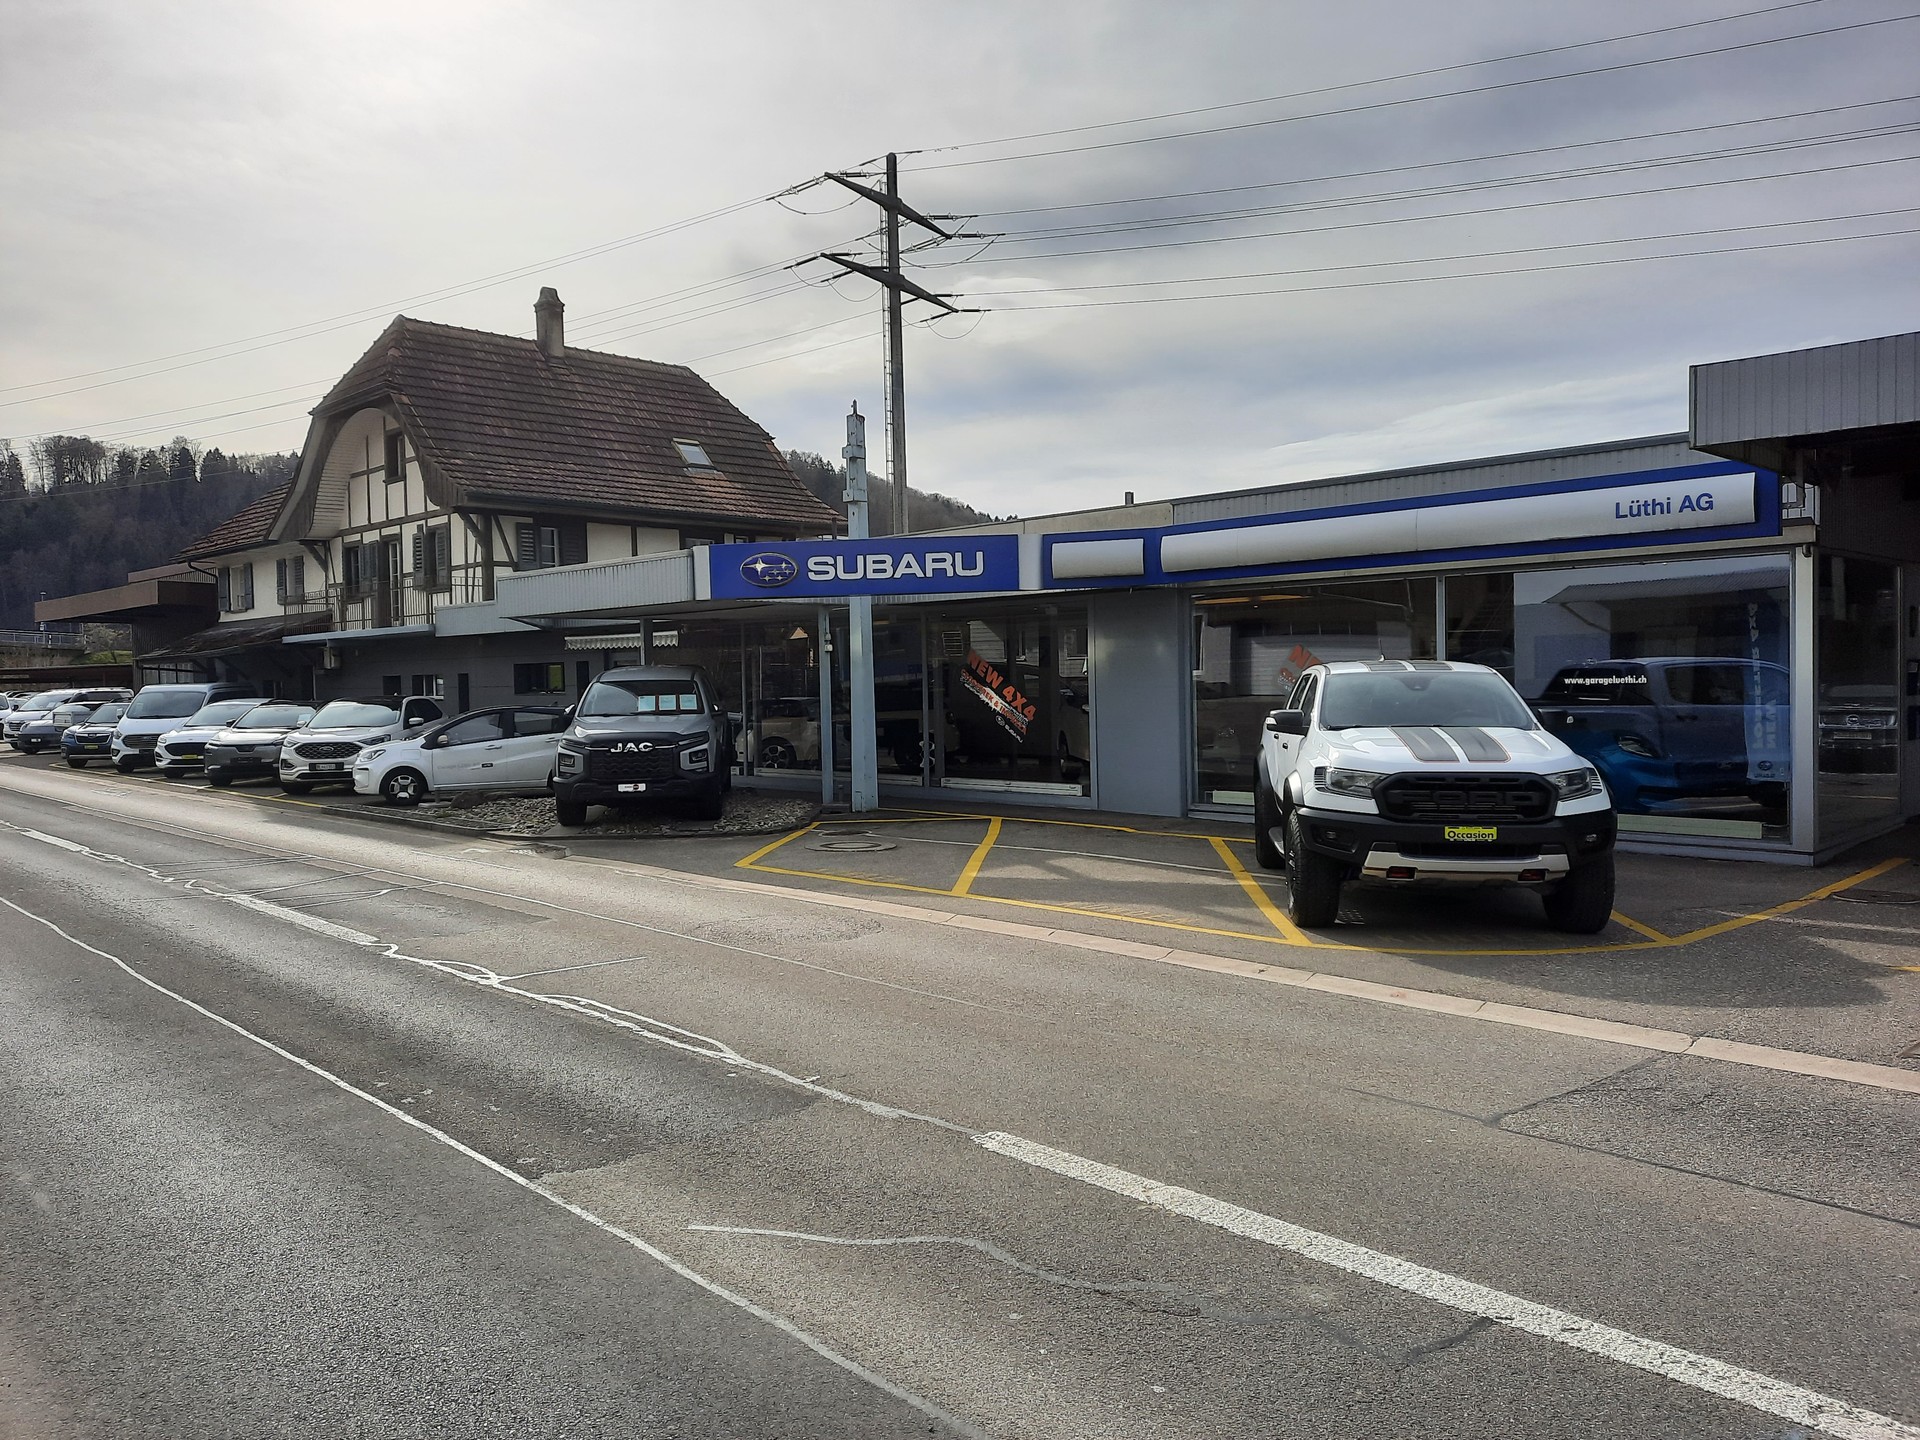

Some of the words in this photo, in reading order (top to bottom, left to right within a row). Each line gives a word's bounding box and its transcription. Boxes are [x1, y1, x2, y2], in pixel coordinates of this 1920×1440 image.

[1615, 497, 1671, 519] Lüthi
[1678, 493, 1714, 513] AG
[807, 551, 984, 581] SUBARU
[967, 649, 1004, 689] NEW
[1564, 675, 1647, 686] www.garageluethi.ch
[610, 742, 653, 753] JAC
[1389, 790, 1542, 806] FORD
[1447, 830, 1494, 839] Occasion
